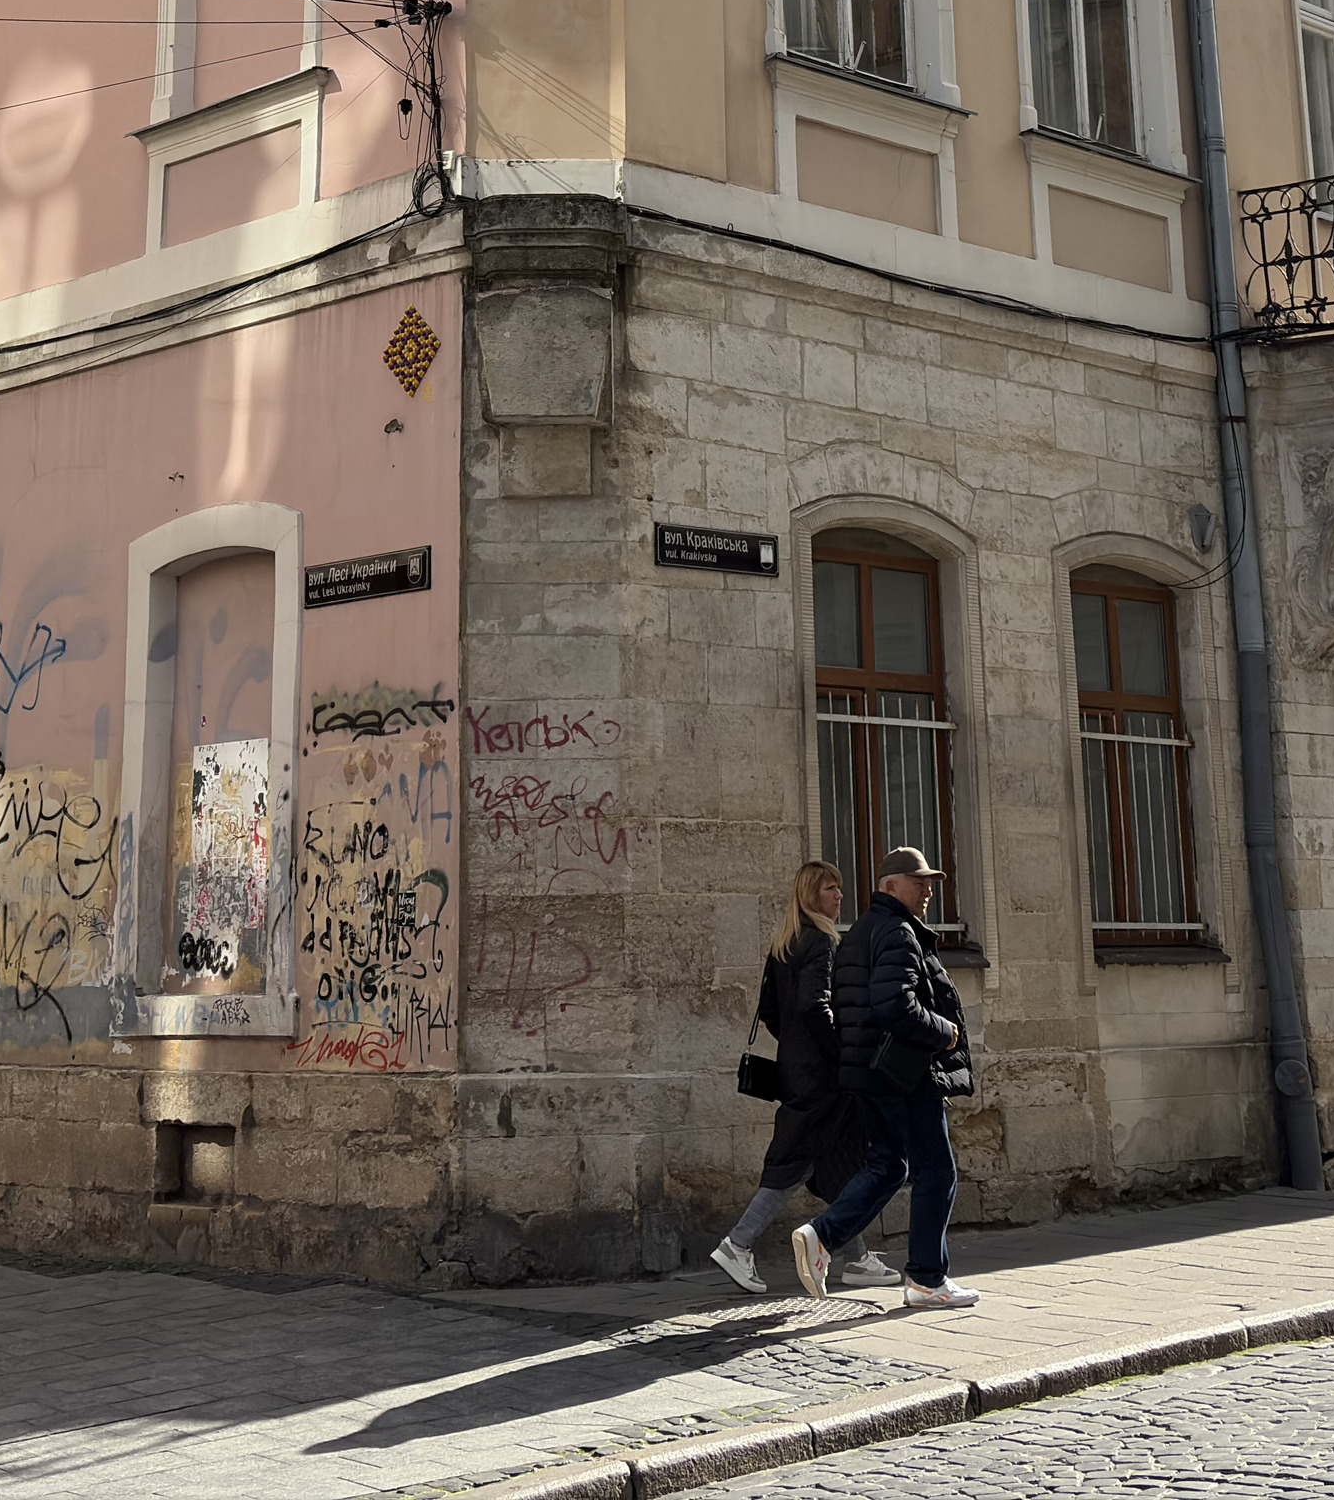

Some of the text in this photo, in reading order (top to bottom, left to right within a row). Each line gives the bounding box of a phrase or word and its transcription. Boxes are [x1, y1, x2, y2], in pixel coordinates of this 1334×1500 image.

[665, 530, 748, 553] вул. Краківська
[665, 549, 717, 563] vul. Krakivska
[308, 559, 397, 587] вул. Лесі Українки
[308, 581, 371, 600] vul. Lesi Ukrayinky
